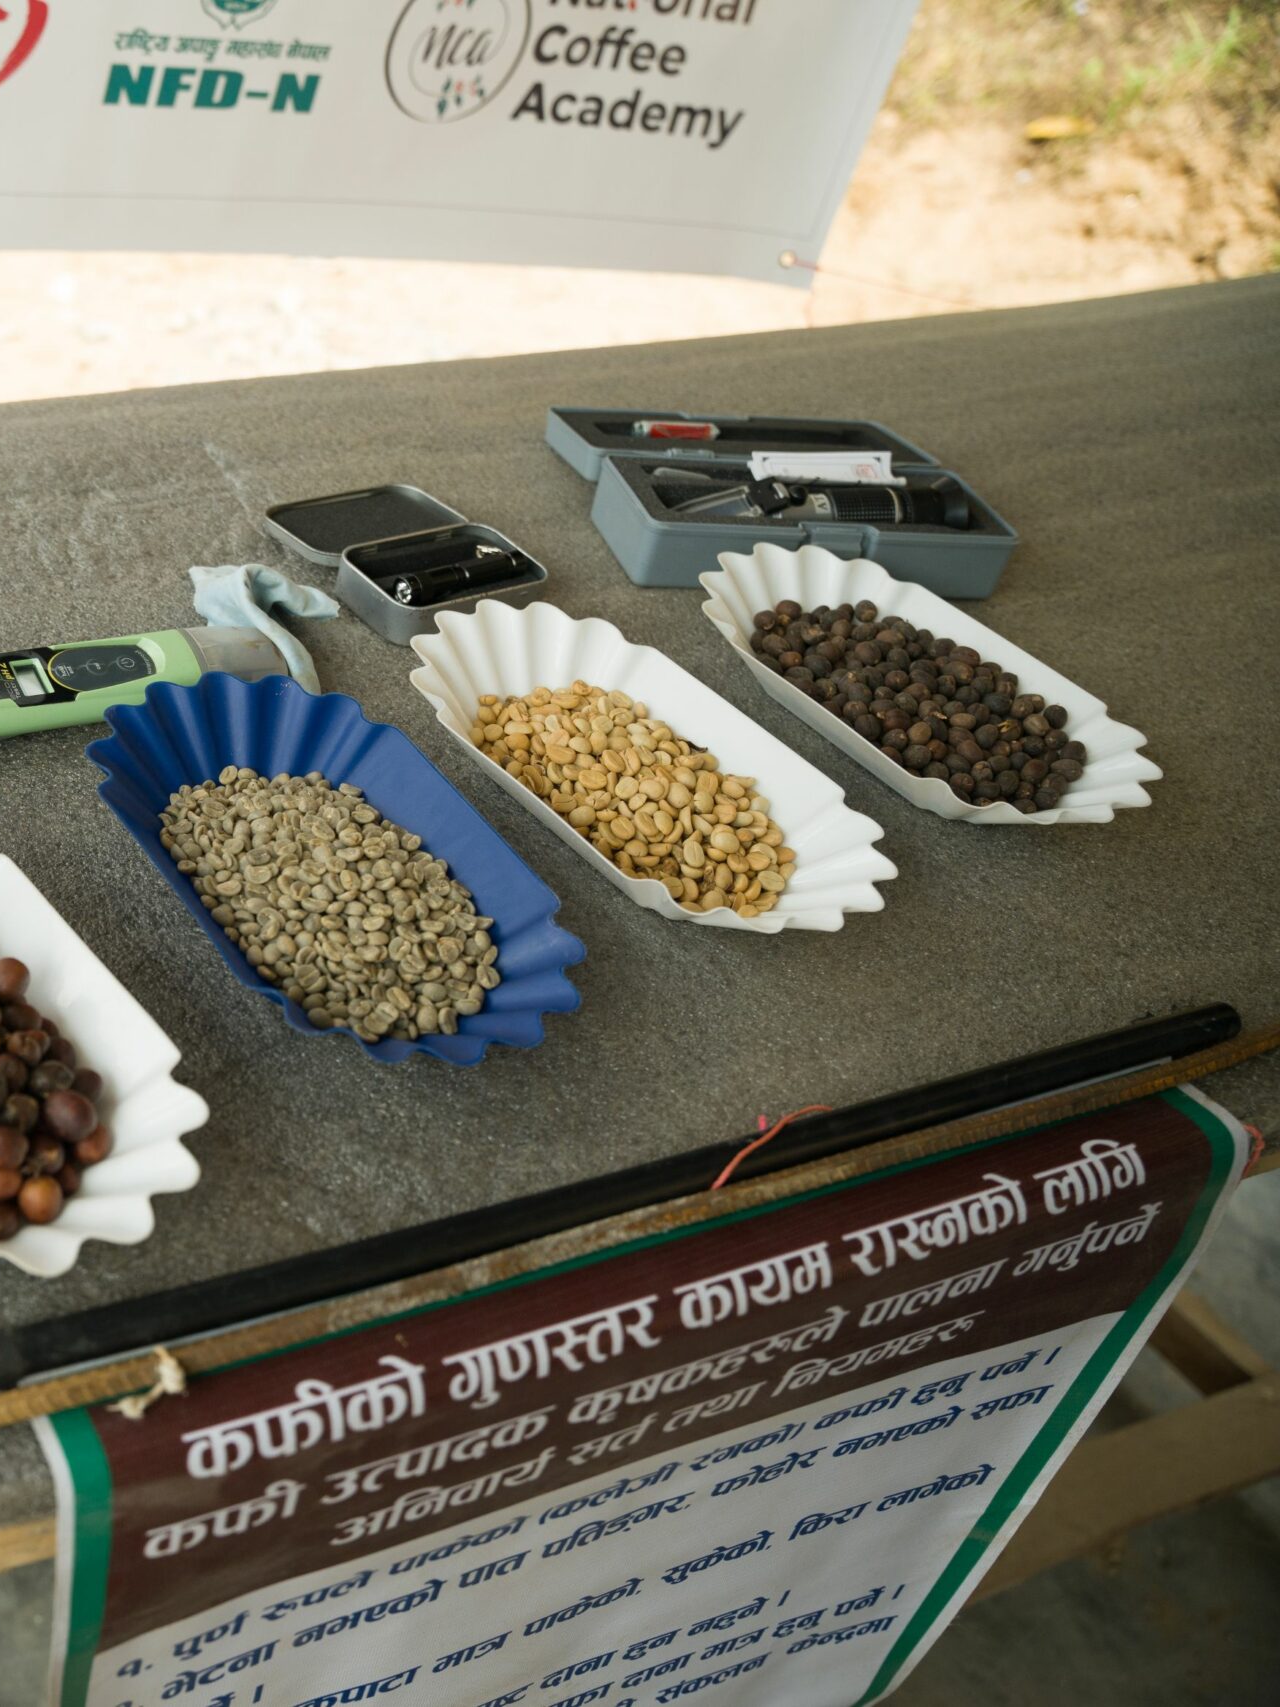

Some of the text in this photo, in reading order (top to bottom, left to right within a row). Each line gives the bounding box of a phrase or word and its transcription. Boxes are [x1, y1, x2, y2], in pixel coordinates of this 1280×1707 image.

[103, 64, 320, 112] NFD-N
[510, 82, 744, 149] Academy
[533, 24, 687, 76] Coffee
[181, 1139, 1146, 1479] कफीको गुणस्तर कायम राख्नको लागि
[143, 1480, 306, 1560] कफी
[321, 1405, 557, 1506] उत्पादक
[859, 1257, 1009, 1328] पालना
[1013, 1201, 1163, 1277] गर्नुपर्ने
[173, 1610, 251, 1660] पुर्ण
[389, 1515, 531, 1576] पाकेको
[813, 1387, 910, 1430] कफी
[911, 1371, 976, 1405] हुनु
[980, 1349, 1042, 1381] पर्ने
[292, 1578, 448, 1647] नभएको
[459, 1550, 531, 1588] पात
[711, 1447, 827, 1496] फोहोर
[832, 1405, 965, 1457] नभएको
[971, 1385, 1054, 1420] सफा
[329, 1446, 557, 1546] अनिवार्य
[566, 1412, 659, 1468] सर्त
[663, 1381, 767, 1433] तथा
[432, 1630, 513, 1673] मात्र
[788, 1501, 871, 1541] किरा
[876, 1463, 996, 1512] लागेको
[540, 1650, 618, 1689] दाना
[622, 1628, 682, 1661] हुन
[687, 1597, 769, 1637] नहुने
[621, 1651, 695, 1689] दाना
[700, 1626, 769, 1661] मात्र
[772, 1608, 828, 1638] हुनु
[834, 1585, 887, 1616] पर्ने
[655, 1615, 898, 1705] संकलन केन्द्रमा
